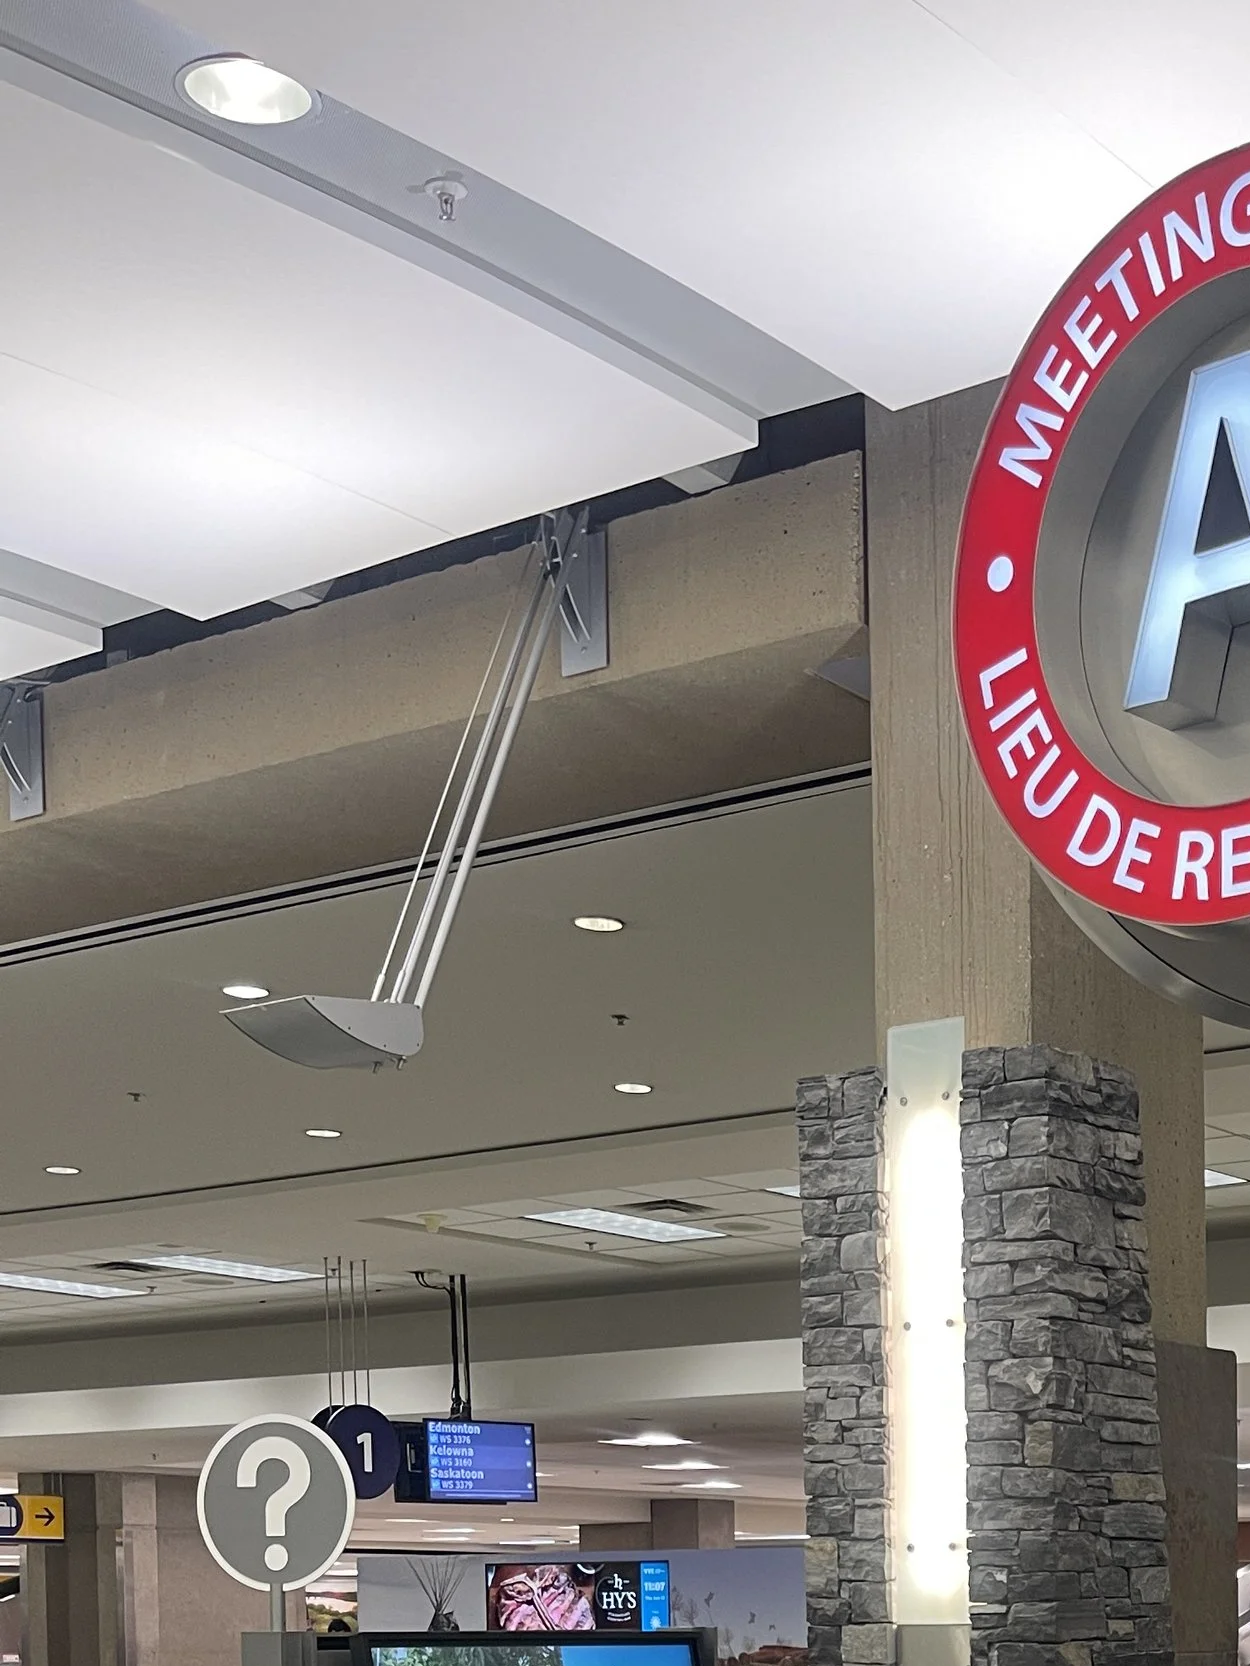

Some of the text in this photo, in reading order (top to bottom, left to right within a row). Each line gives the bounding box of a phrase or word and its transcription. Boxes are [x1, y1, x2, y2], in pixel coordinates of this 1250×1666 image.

[978, 646, 1081, 820] LIEU
[1066, 792, 1161, 894] DE
[428, 1421, 481, 1435] Edmonton
[439, 1435, 453, 1444] WS
[356, 1431, 374, 1473] 1
[429, 1444, 474, 1457] Kelowna
[440, 1458, 453, 1467] WS
[430, 1467, 485, 1480] Saskatoon
[441, 1480, 454, 1489] WS
